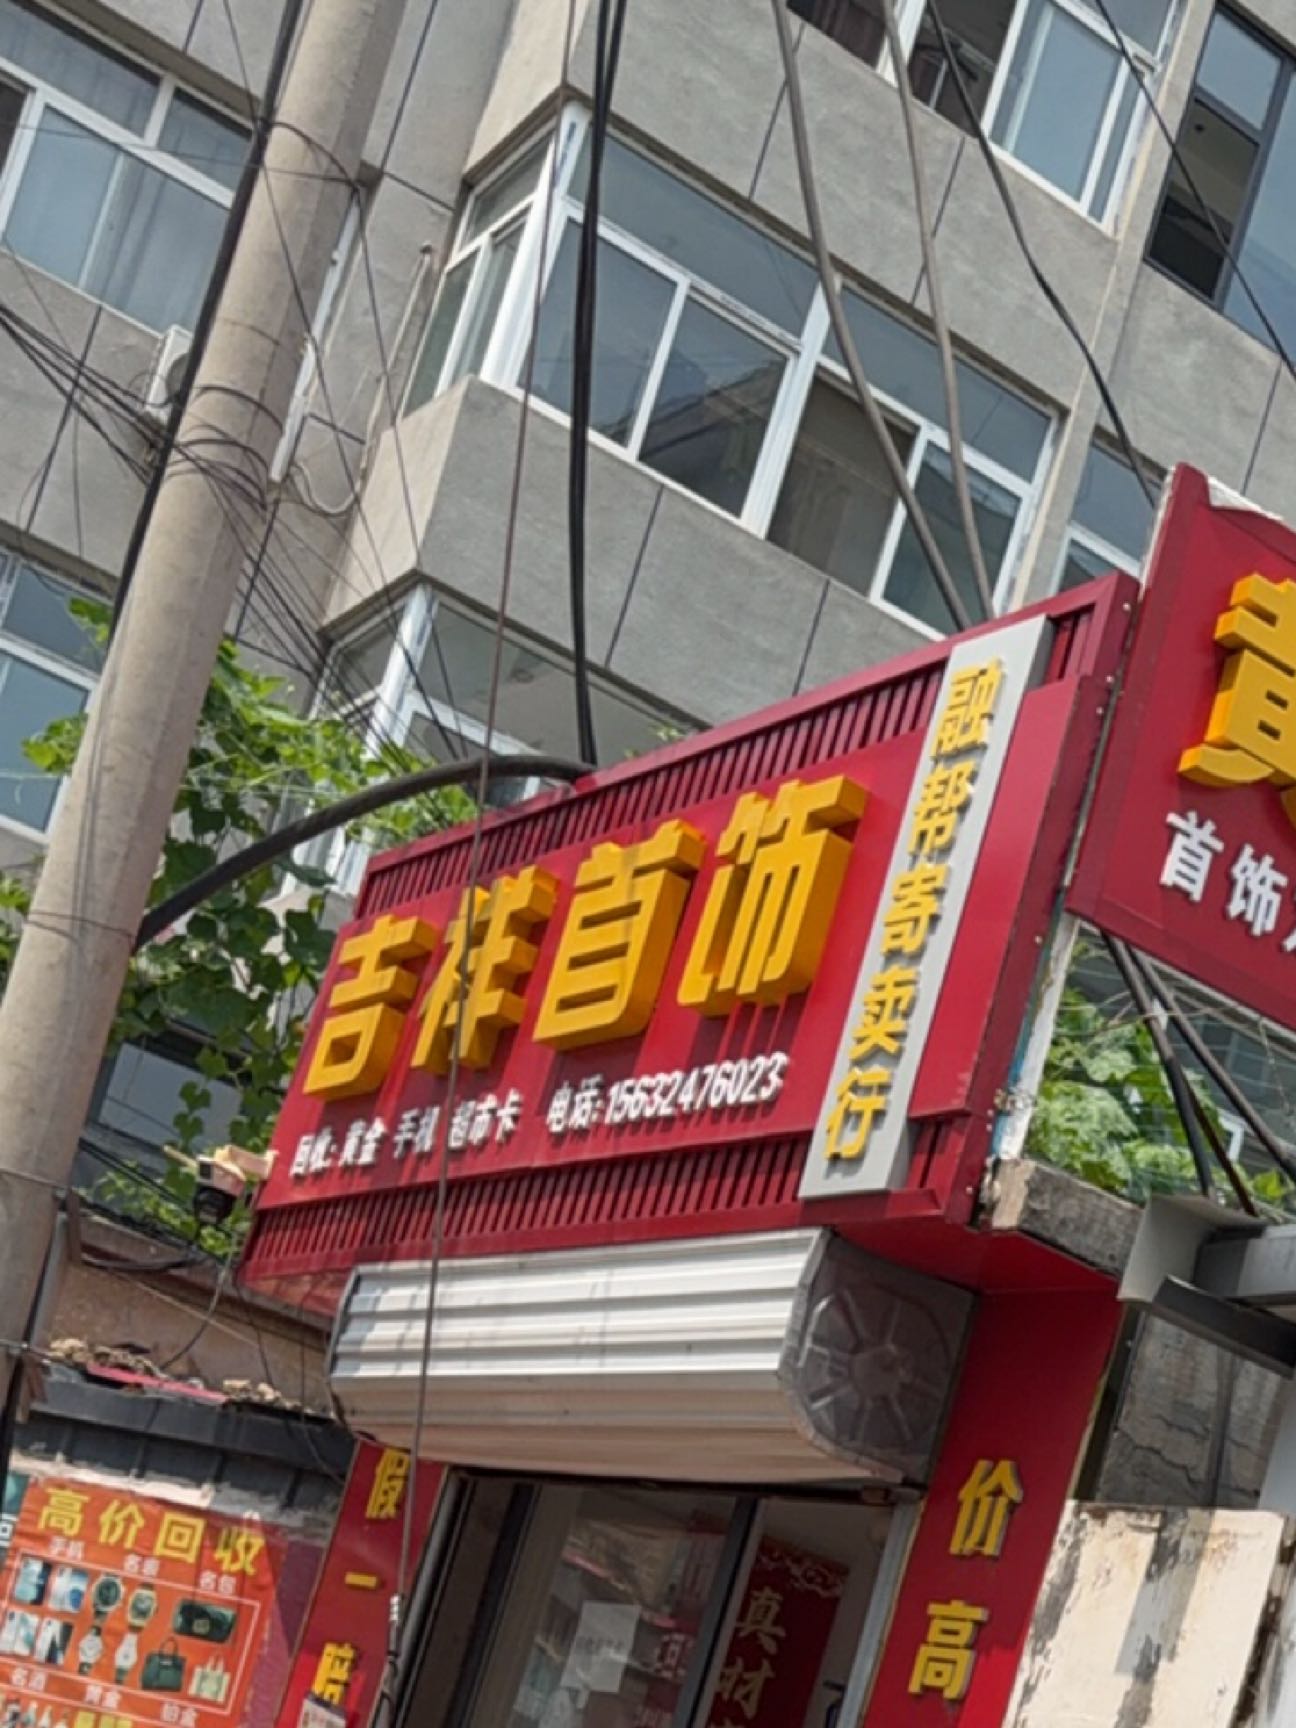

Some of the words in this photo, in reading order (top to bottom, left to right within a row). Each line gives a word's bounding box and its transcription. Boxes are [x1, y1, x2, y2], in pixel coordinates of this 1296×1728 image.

[302, 775, 874, 1102] 吉祥首饰
[824, 656, 1003, 1162] 融帮寄卖行
[393, 1105, 440, 1160] 手机
[37, 1488, 265, 1575] 高价回收
